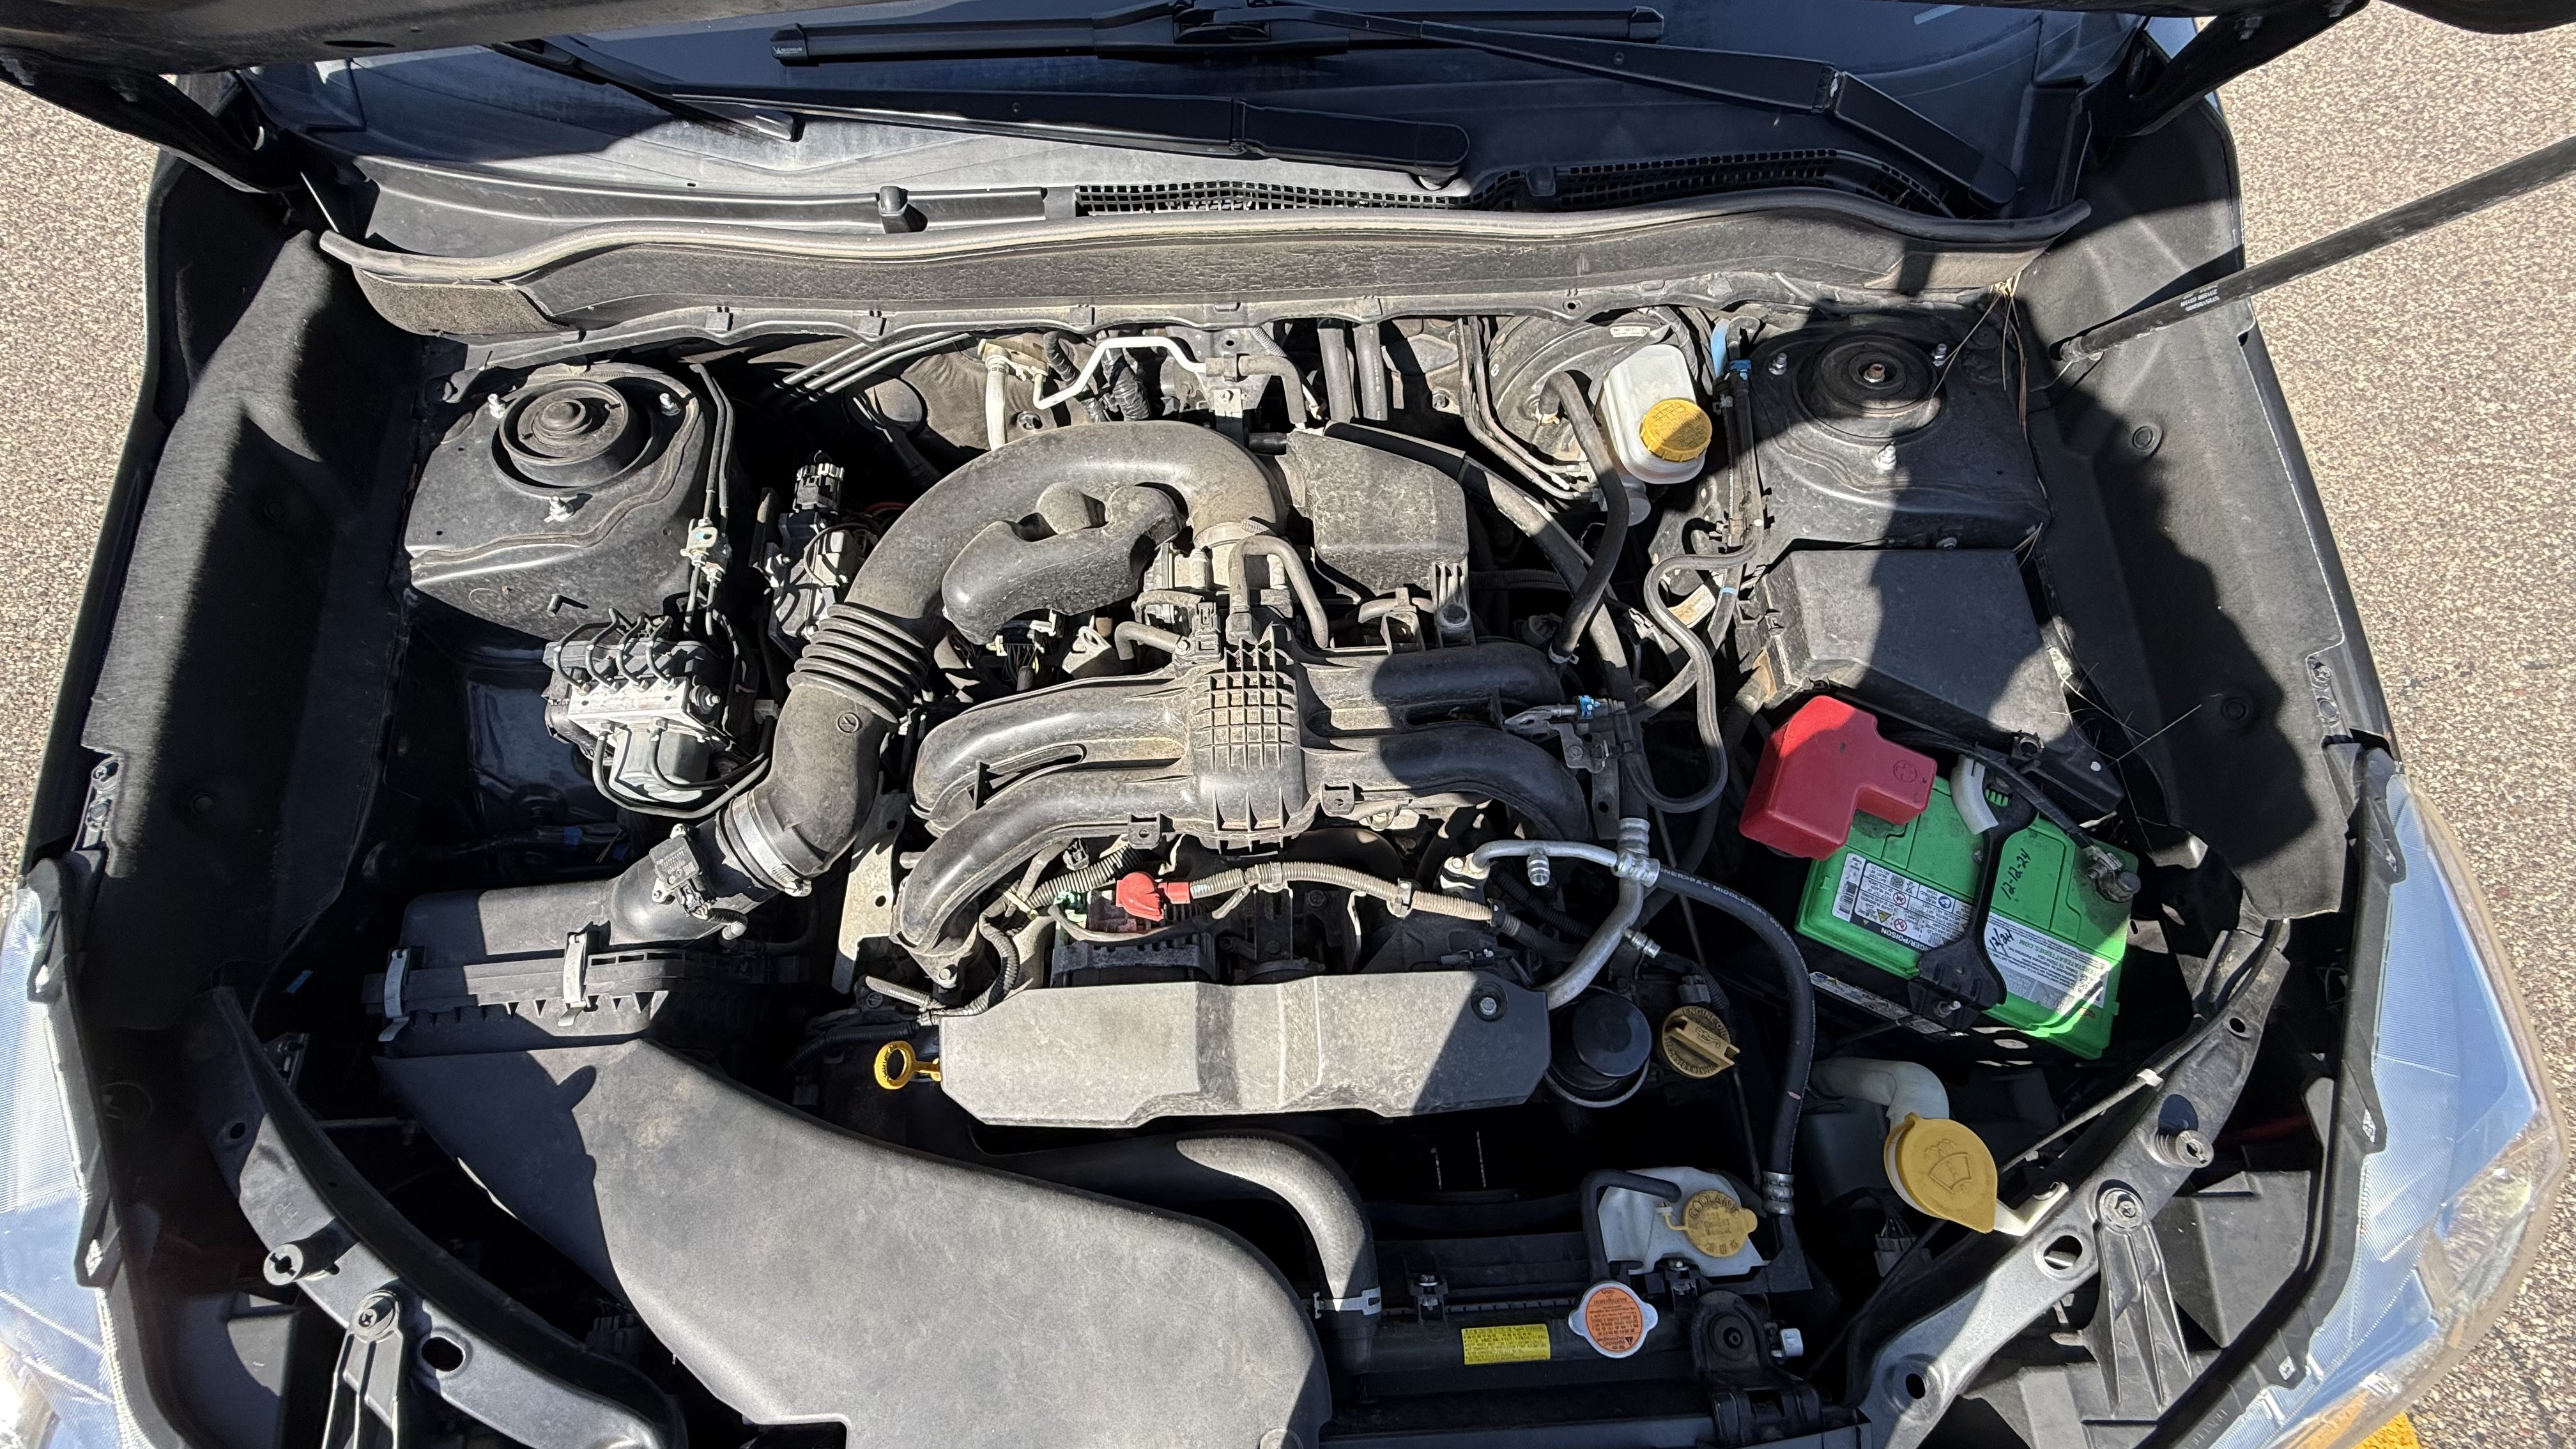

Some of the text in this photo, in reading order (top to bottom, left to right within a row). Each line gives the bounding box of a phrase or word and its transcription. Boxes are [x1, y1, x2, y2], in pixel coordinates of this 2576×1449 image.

[2000, 847, 2031, 900] 12-12-24
[2018, 939, 2099, 977] TERSTATEBATTERIES.COM
[1683, 1008, 1717, 1023] ENGINE
[1717, 1023, 1729, 1038] OIL
[1688, 1194, 1740, 1219] COOLANT
